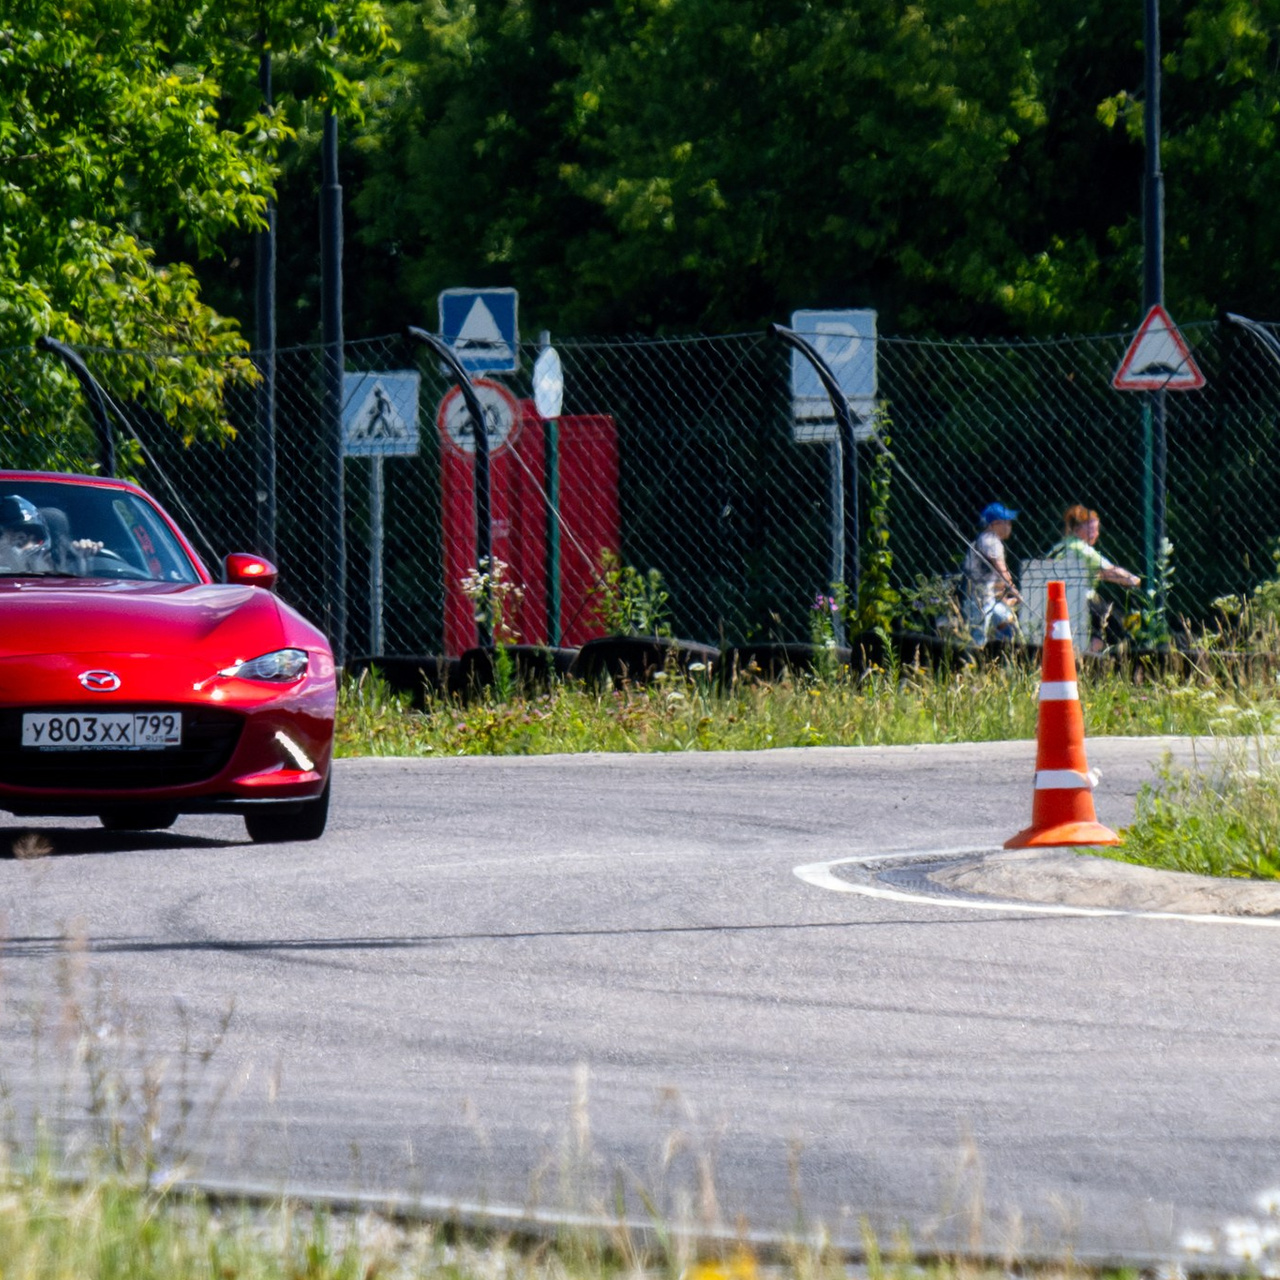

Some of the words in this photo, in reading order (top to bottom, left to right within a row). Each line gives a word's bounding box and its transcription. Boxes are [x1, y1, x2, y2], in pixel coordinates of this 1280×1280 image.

[815, 322, 861, 385] P
[136, 715, 175, 735] 799
[145, 734, 164, 743] RUS
